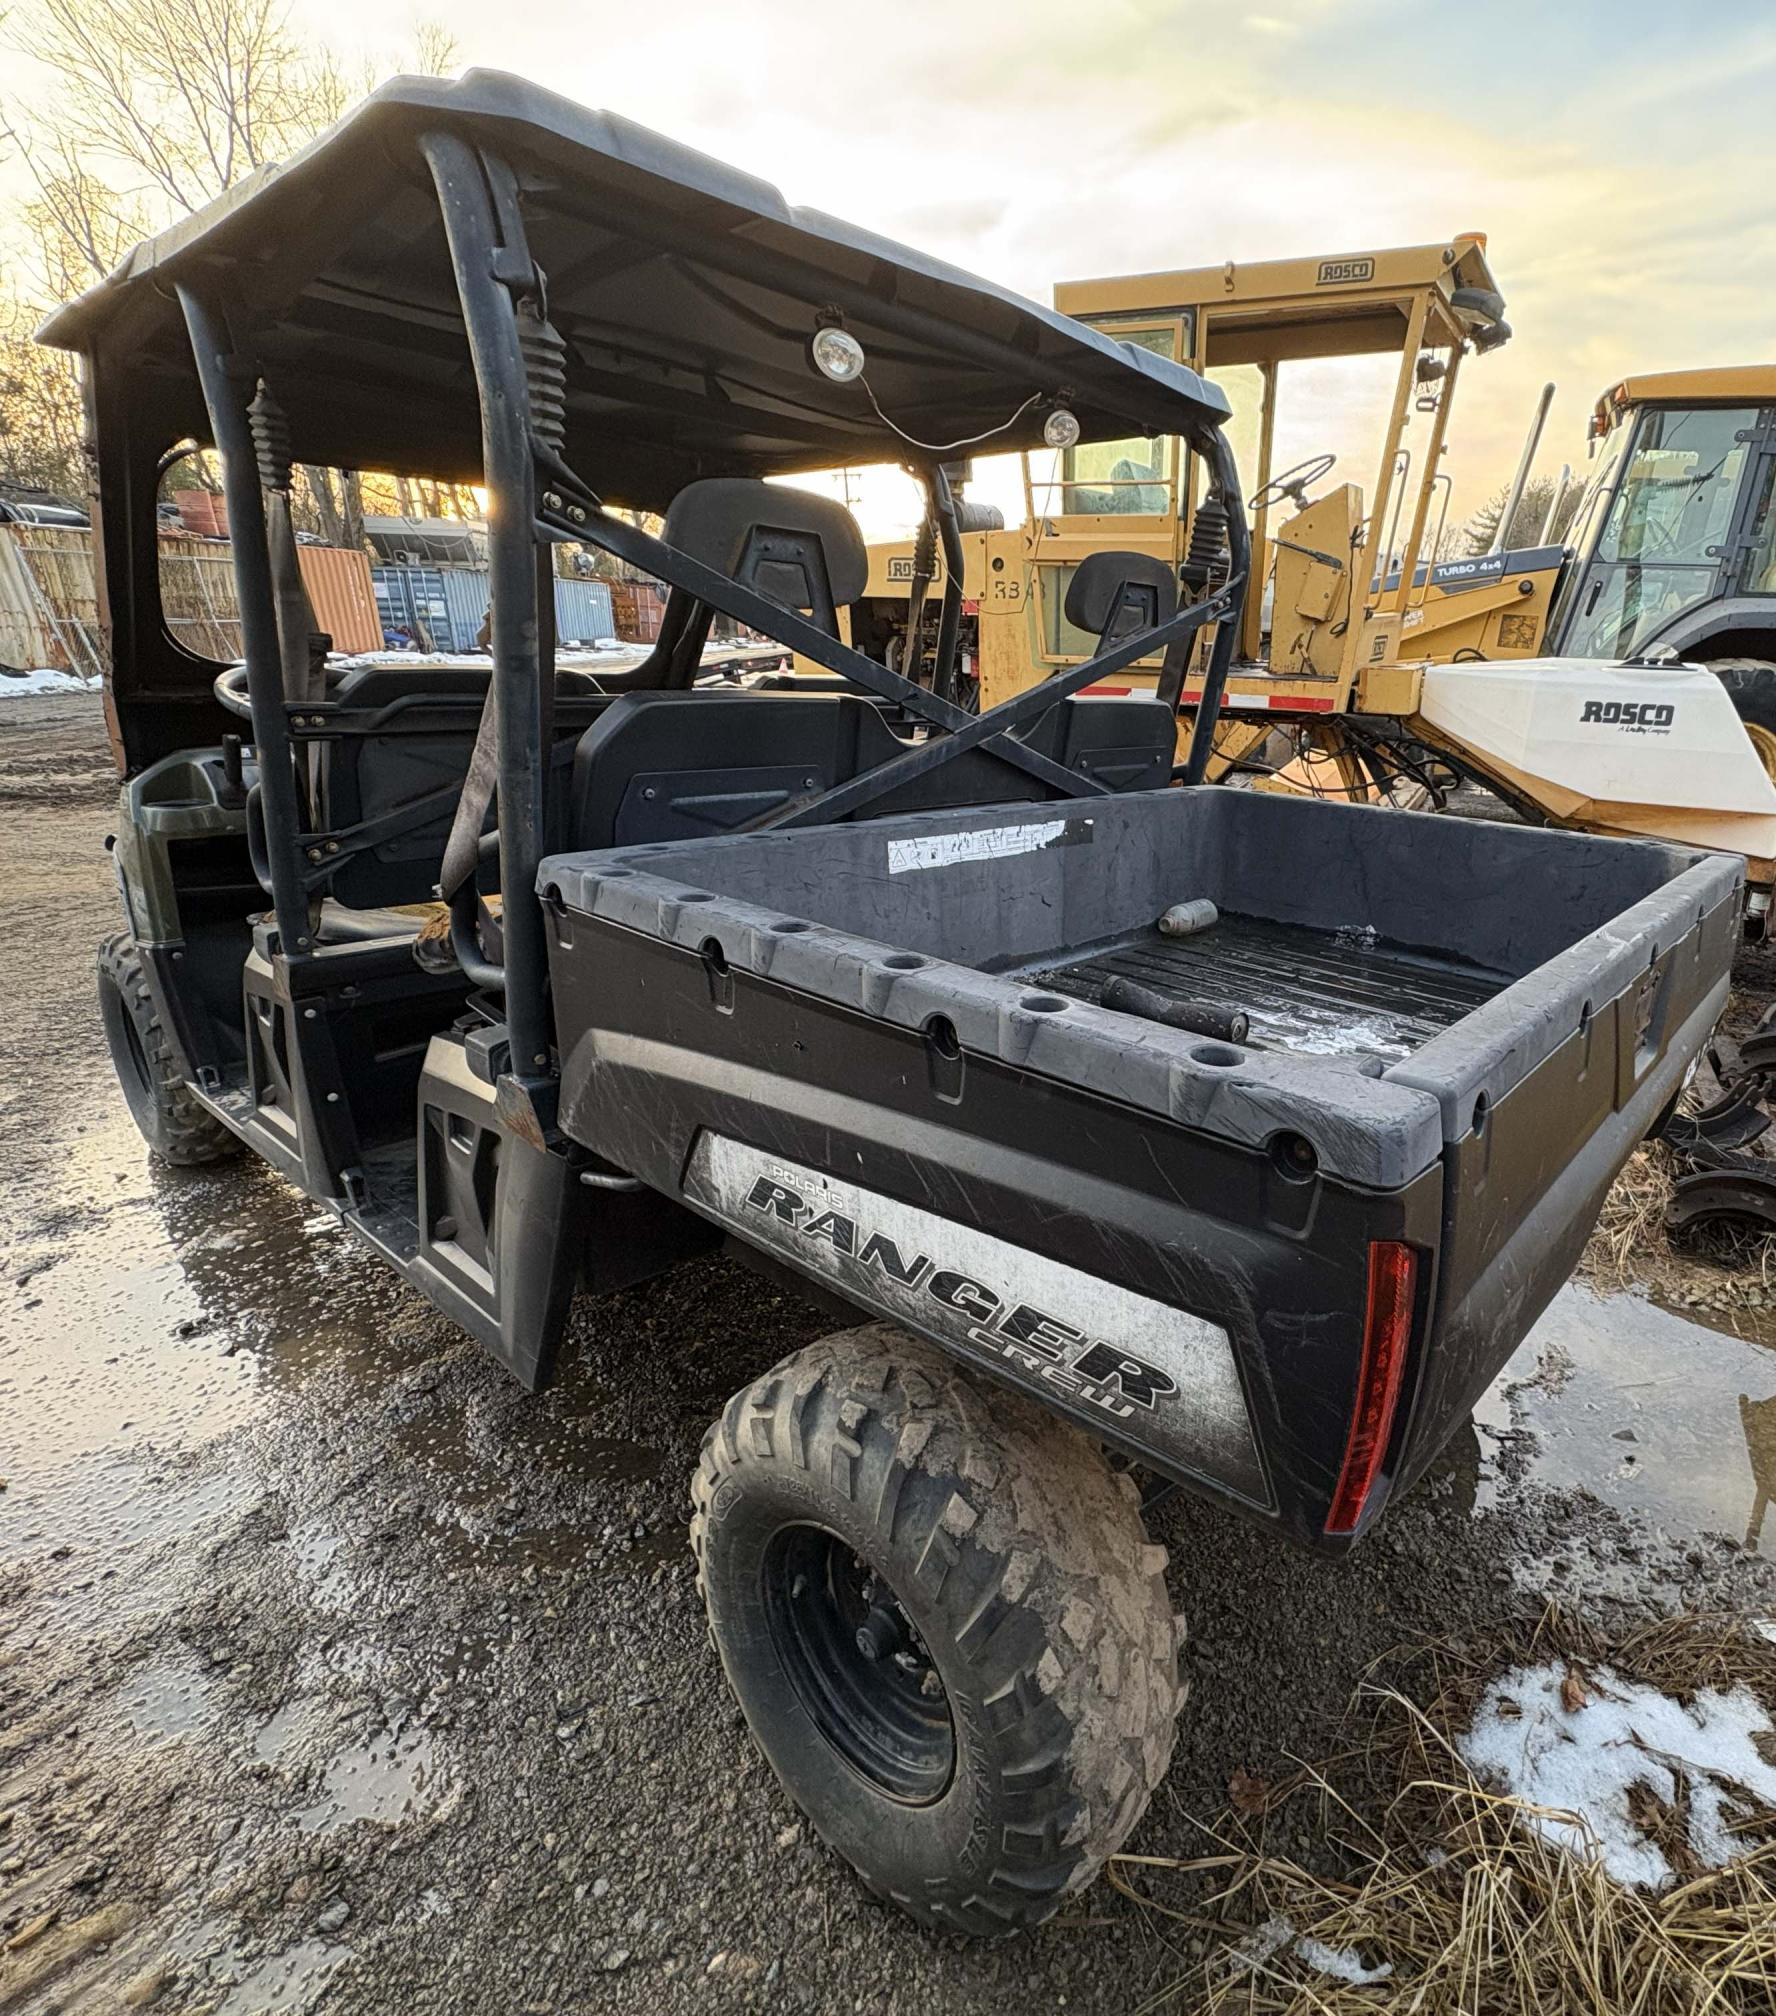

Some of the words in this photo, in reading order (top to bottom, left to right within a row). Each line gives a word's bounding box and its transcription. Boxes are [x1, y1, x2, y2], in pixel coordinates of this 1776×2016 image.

[1322, 262, 1370, 281] ROSCO
[1437, 563, 1475, 577] TURBO
[1479, 560, 1502, 571] 4x4
[1579, 700, 1675, 727] ROSCO
[772, 1165, 844, 1209] POLARIS
[745, 1174, 1178, 1411] RANGER
[966, 1326, 1137, 1418] CREW
